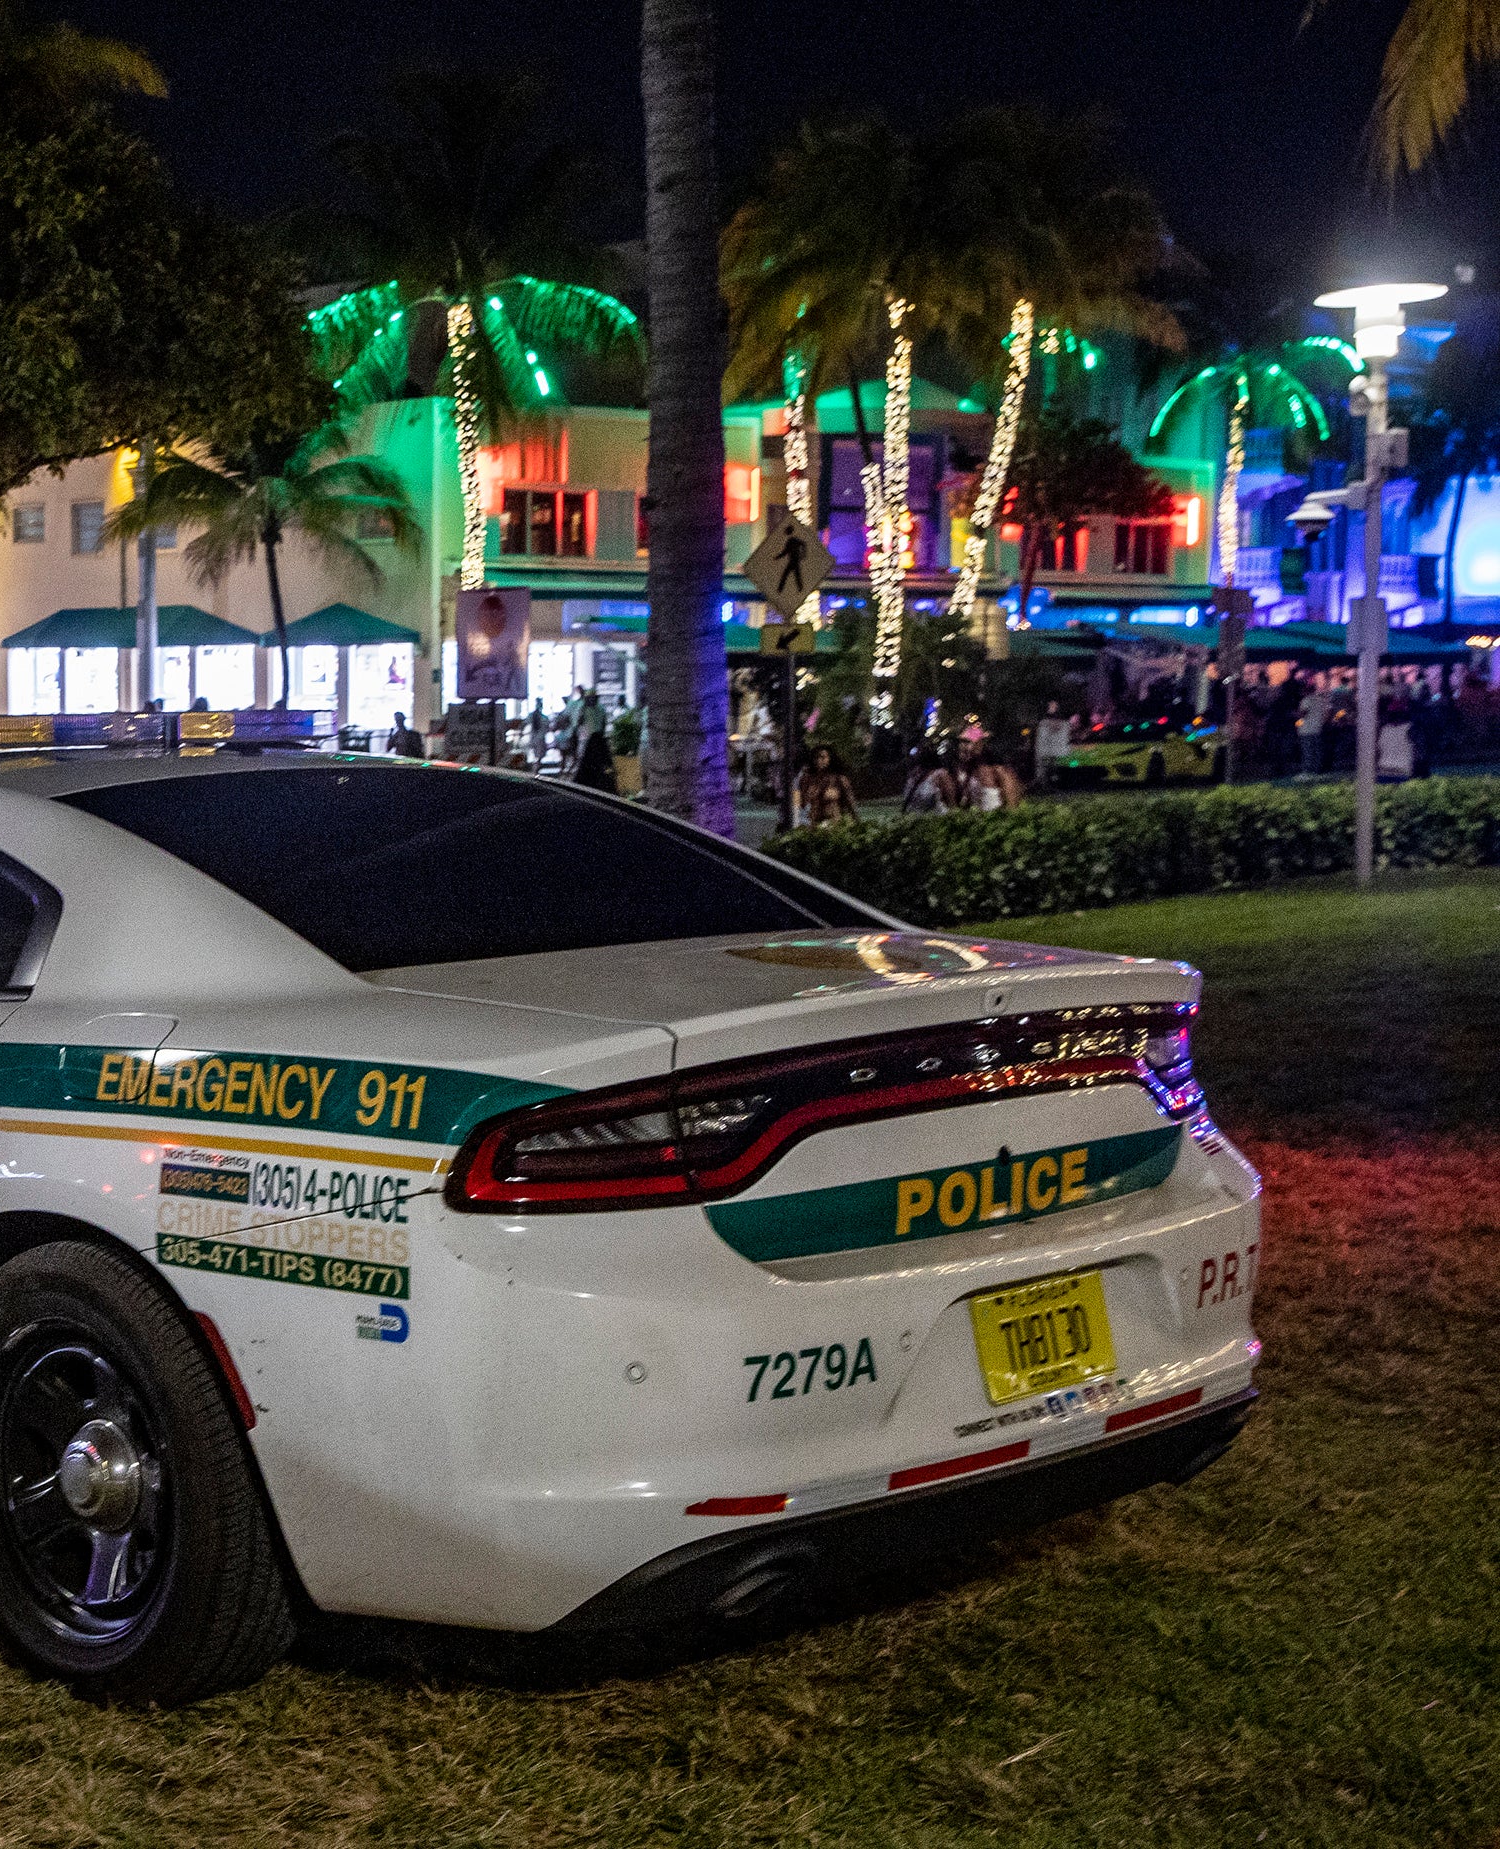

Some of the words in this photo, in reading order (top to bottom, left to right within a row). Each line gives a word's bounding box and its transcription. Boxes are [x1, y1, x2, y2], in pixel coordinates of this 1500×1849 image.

[95, 1052, 338, 1122] EMERGENCY
[355, 1069, 429, 1130] 911
[894, 1147, 1091, 1236] POLICE
[157, 1200, 243, 1243] CRIME
[250, 1210, 411, 1265] STOPPERS
[161, 1236, 317, 1284] 305-471-TIPS
[322, 1258, 404, 1297] (8477)
[743, 1336, 878, 1403] 7279A
